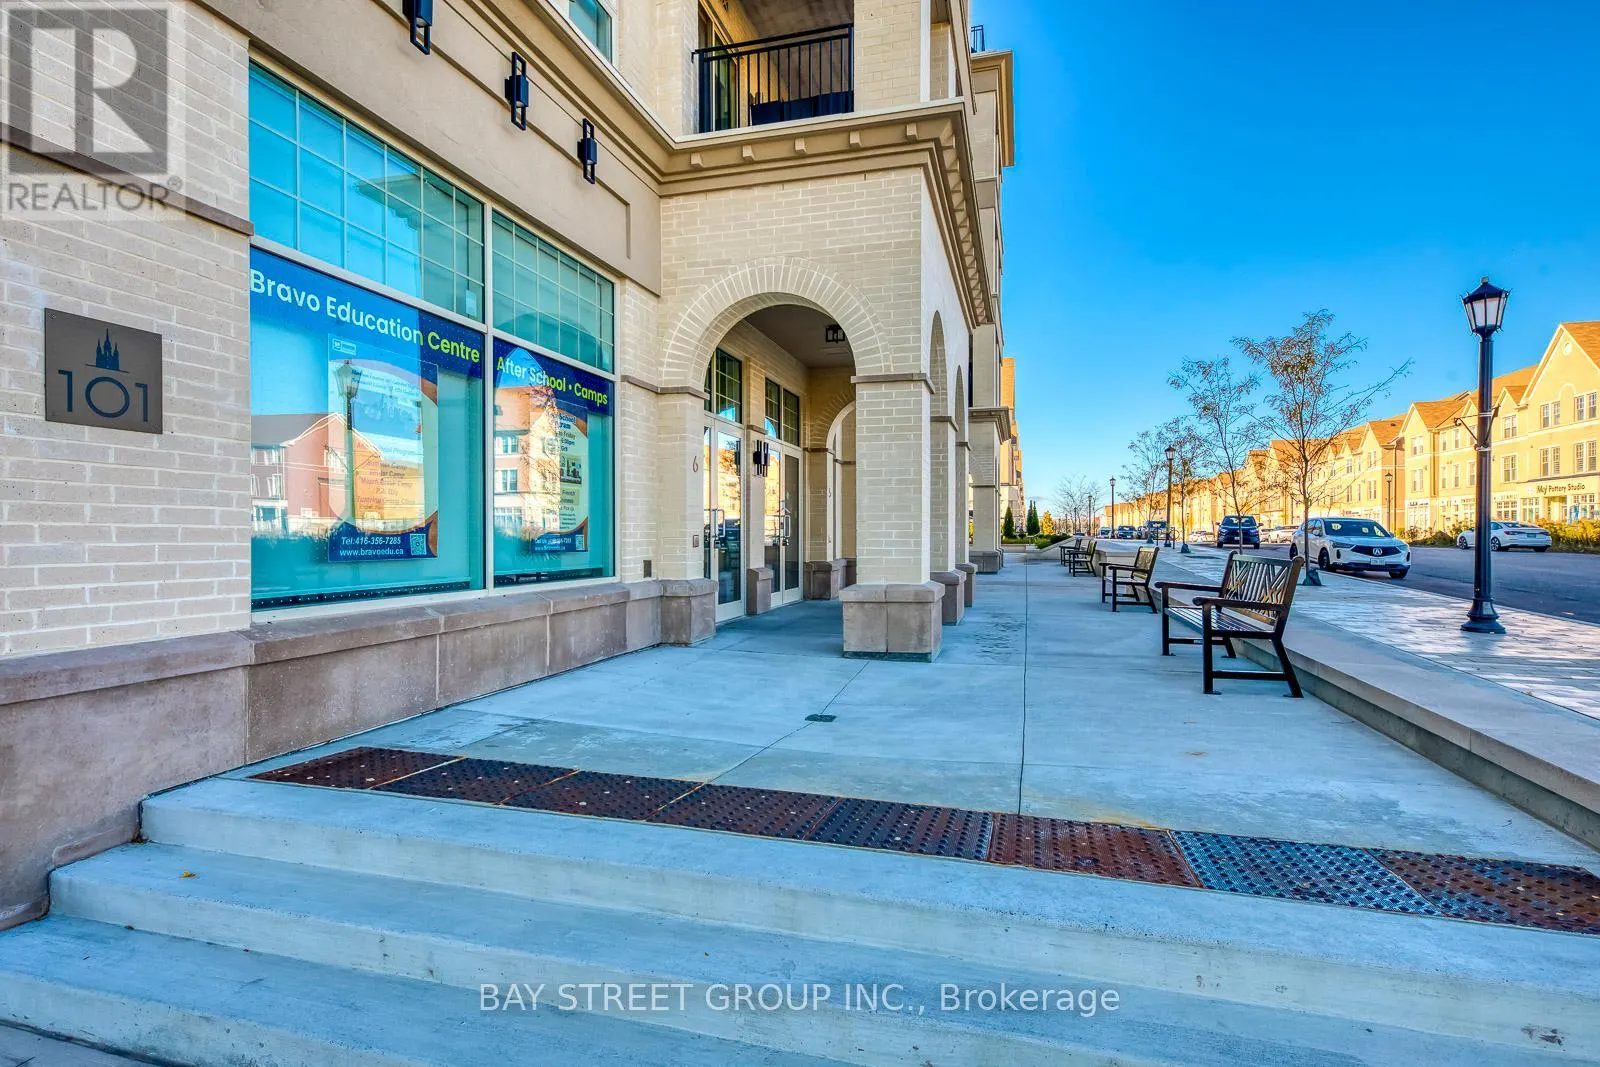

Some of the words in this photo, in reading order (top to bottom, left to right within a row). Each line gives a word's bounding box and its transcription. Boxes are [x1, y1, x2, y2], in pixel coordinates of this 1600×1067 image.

[250, 269, 320, 312] Bravo
[326, 295, 423, 346] Education
[427, 331, 480, 363] Centre
[57, 369, 149, 422] 101
[496, 356, 527, 379] After
[529, 367, 566, 392] School
[574, 383, 608, 407] Camps
[692, 455, 699, 473] 6
[1536, 485, 1548, 495] My
[1548, 485, 1567, 493] Pottery
[1567, 483, 1586, 491] Studio
[339, 547, 404, 556] www.bravoedu.ca
